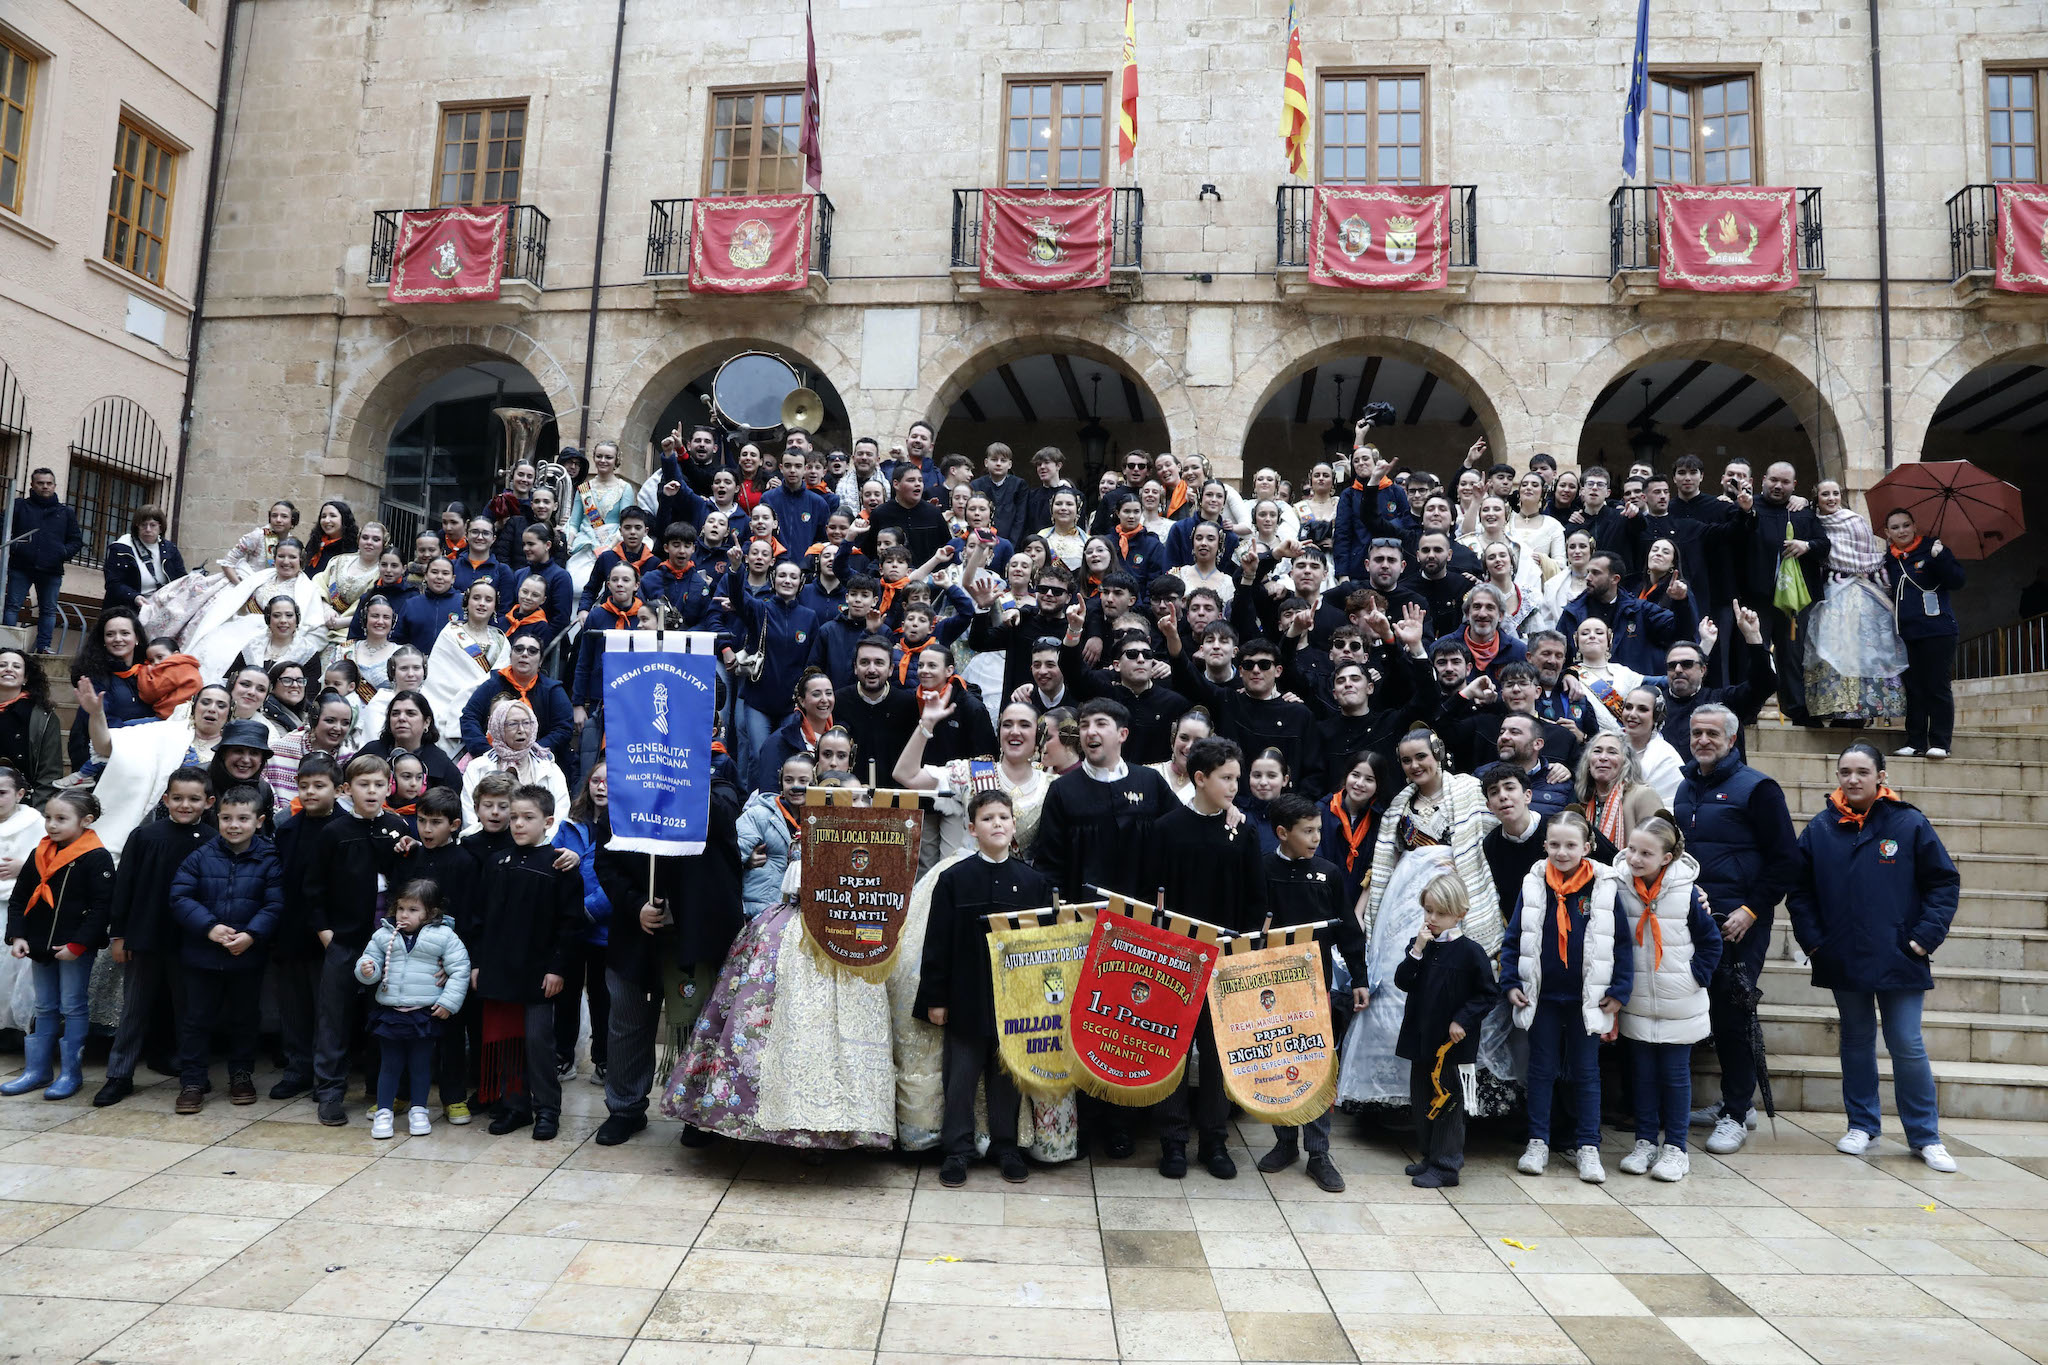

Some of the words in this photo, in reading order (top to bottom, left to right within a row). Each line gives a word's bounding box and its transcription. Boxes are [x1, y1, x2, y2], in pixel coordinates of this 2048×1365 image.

[610, 668, 642, 690] PREMI
[643, 663, 708, 692] GENERALITAT
[627, 743, 691, 758] GENERALITAT
[628, 753, 688, 769] VALENCIANA
[626, 773, 651, 781] MILLOR
[652, 773, 667, 782] FALLA
[643, 781, 655, 789] DEL
[631, 812, 661, 825] FALLES
[663, 816, 687, 828] 2025
[815, 829, 840, 845] JUNTA
[841, 831, 868, 844] LOCAL
[870, 831, 905, 845] FALLERA
[1316, 872, 1327, 882] 75
[827, 940, 849, 958] FALLES
[849, 951, 865, 959] 2025
[1005, 949, 1058, 970] AJUNTAMENT
[1060, 947, 1071, 962] DE
[1111, 938, 1156, 961] AJUNTAMENT
[1157, 953, 1168, 965] DE
[1168, 954, 1191, 973] DÉNIA
[1097, 960, 1126, 978] JUNTA
[1128, 961, 1154, 979] LOCAL
[1154, 971, 1191, 1006] FALLERA
[1219, 979, 1248, 997] JUNTA
[1248, 972, 1272, 991] LOCAL
[1272, 966, 1309, 987] FALLERA
[1004, 1014, 1063, 1035] MILLOR
[1087, 990, 1112, 1017] 1r
[1114, 1005, 1179, 1040] Premi
[1230, 1022, 1254, 1032] PREMI
[1257, 1014, 1284, 1028] MANUEL
[1287, 1010, 1315, 1021] MARCO
[1026, 1035, 1063, 1054] INFA
[1082, 1020, 1120, 1040] SECCIÓ
[1122, 1034, 1171, 1059] ESPECIAL
[1099, 1041, 1145, 1065] INFANTIL
[1233, 1063, 1259, 1076] SECCIÓ
[1261, 1057, 1291, 1071] ESPECIAL
[1293, 1051, 1326, 1062] INFANTIL
[1029, 1064, 1053, 1079] FALLES
[1086, 1050, 1107, 1072] FALLES
[1107, 1066, 1124, 1078] 2025
[1253, 1091, 1278, 1105] FALLES
[1278, 1096, 1292, 1105] 2025
